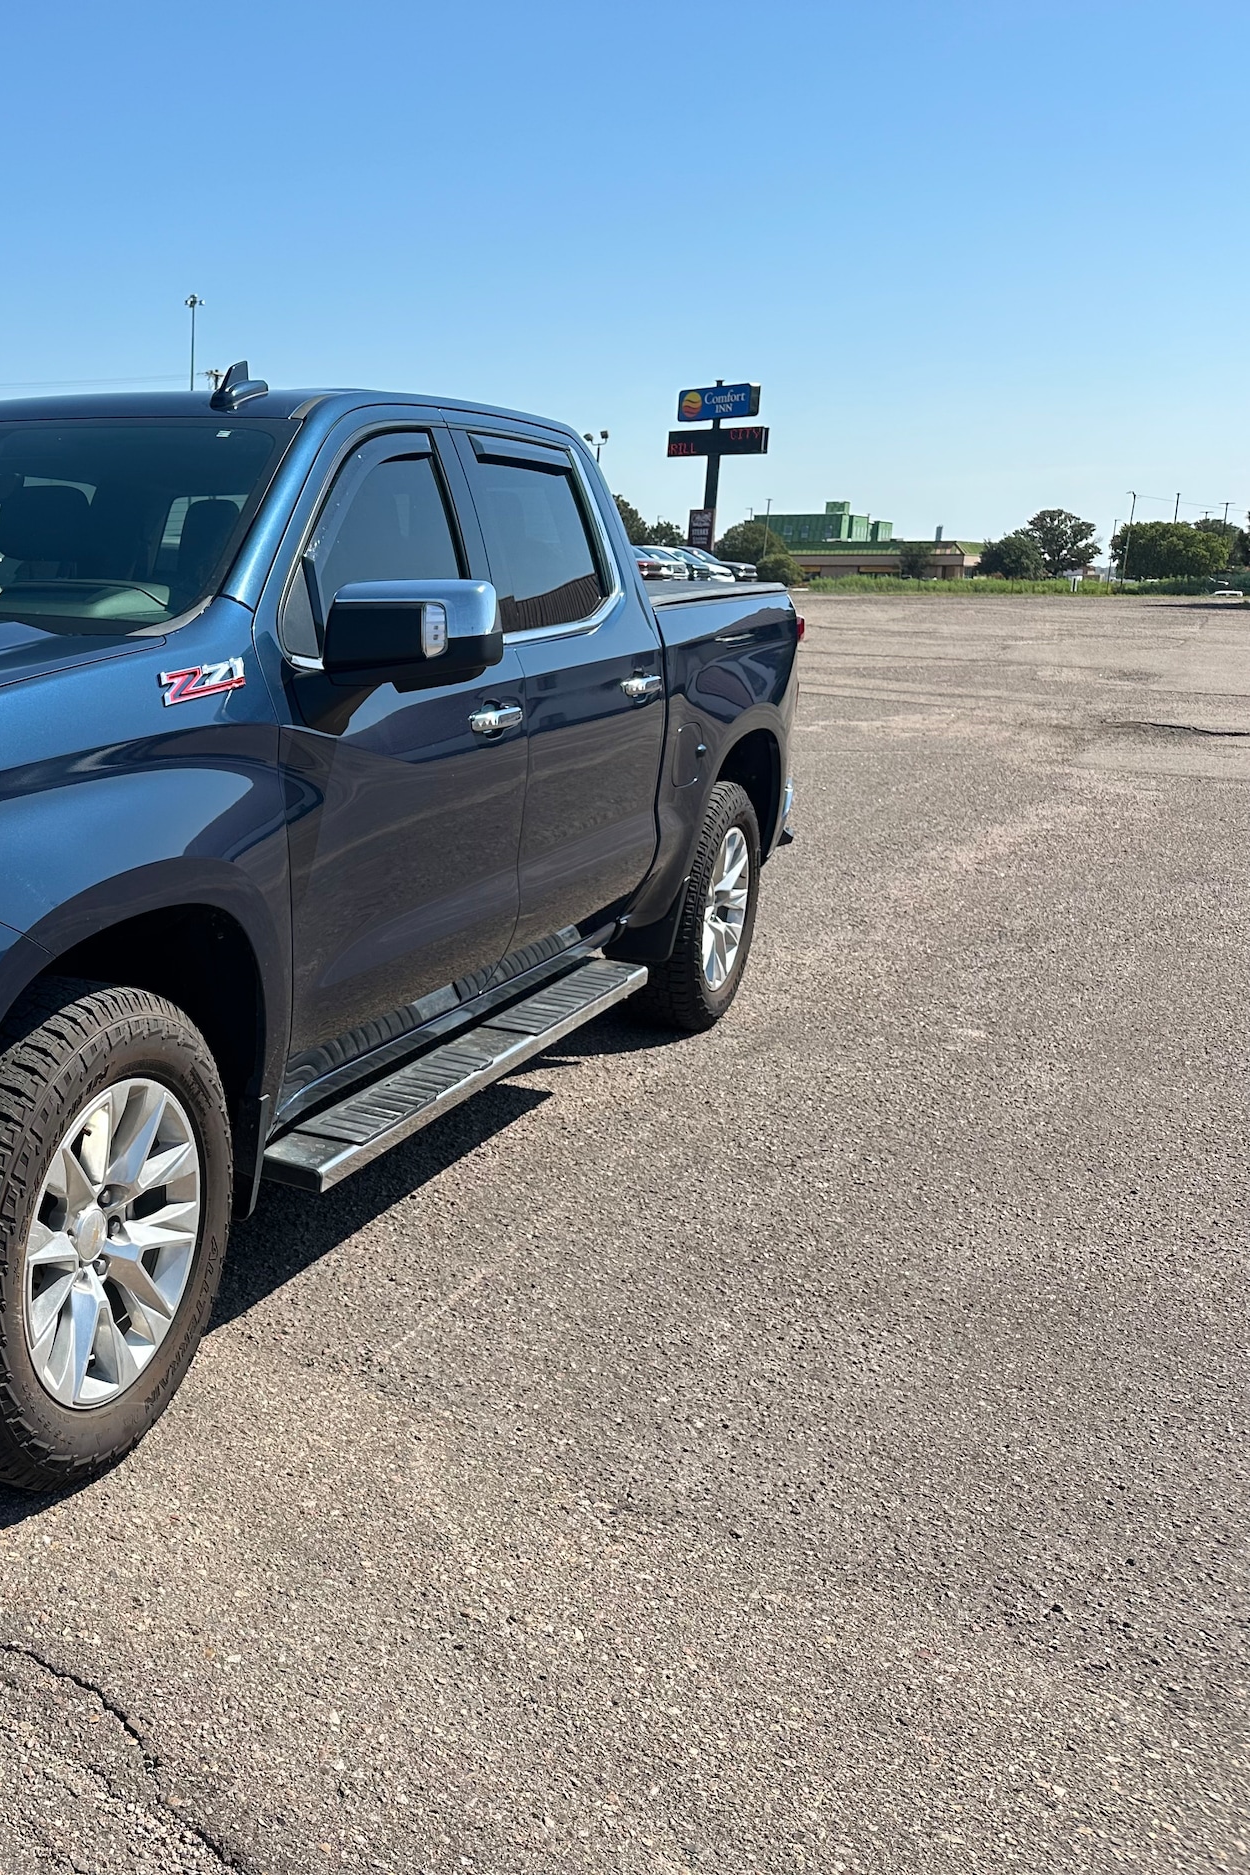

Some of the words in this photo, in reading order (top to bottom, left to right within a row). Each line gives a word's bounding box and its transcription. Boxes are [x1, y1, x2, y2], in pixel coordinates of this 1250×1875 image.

[704, 389, 746, 405] Comfort
[715, 403, 733, 414] INN
[729, 427, 761, 440] CITY
[157, 657, 246, 707] Z71
